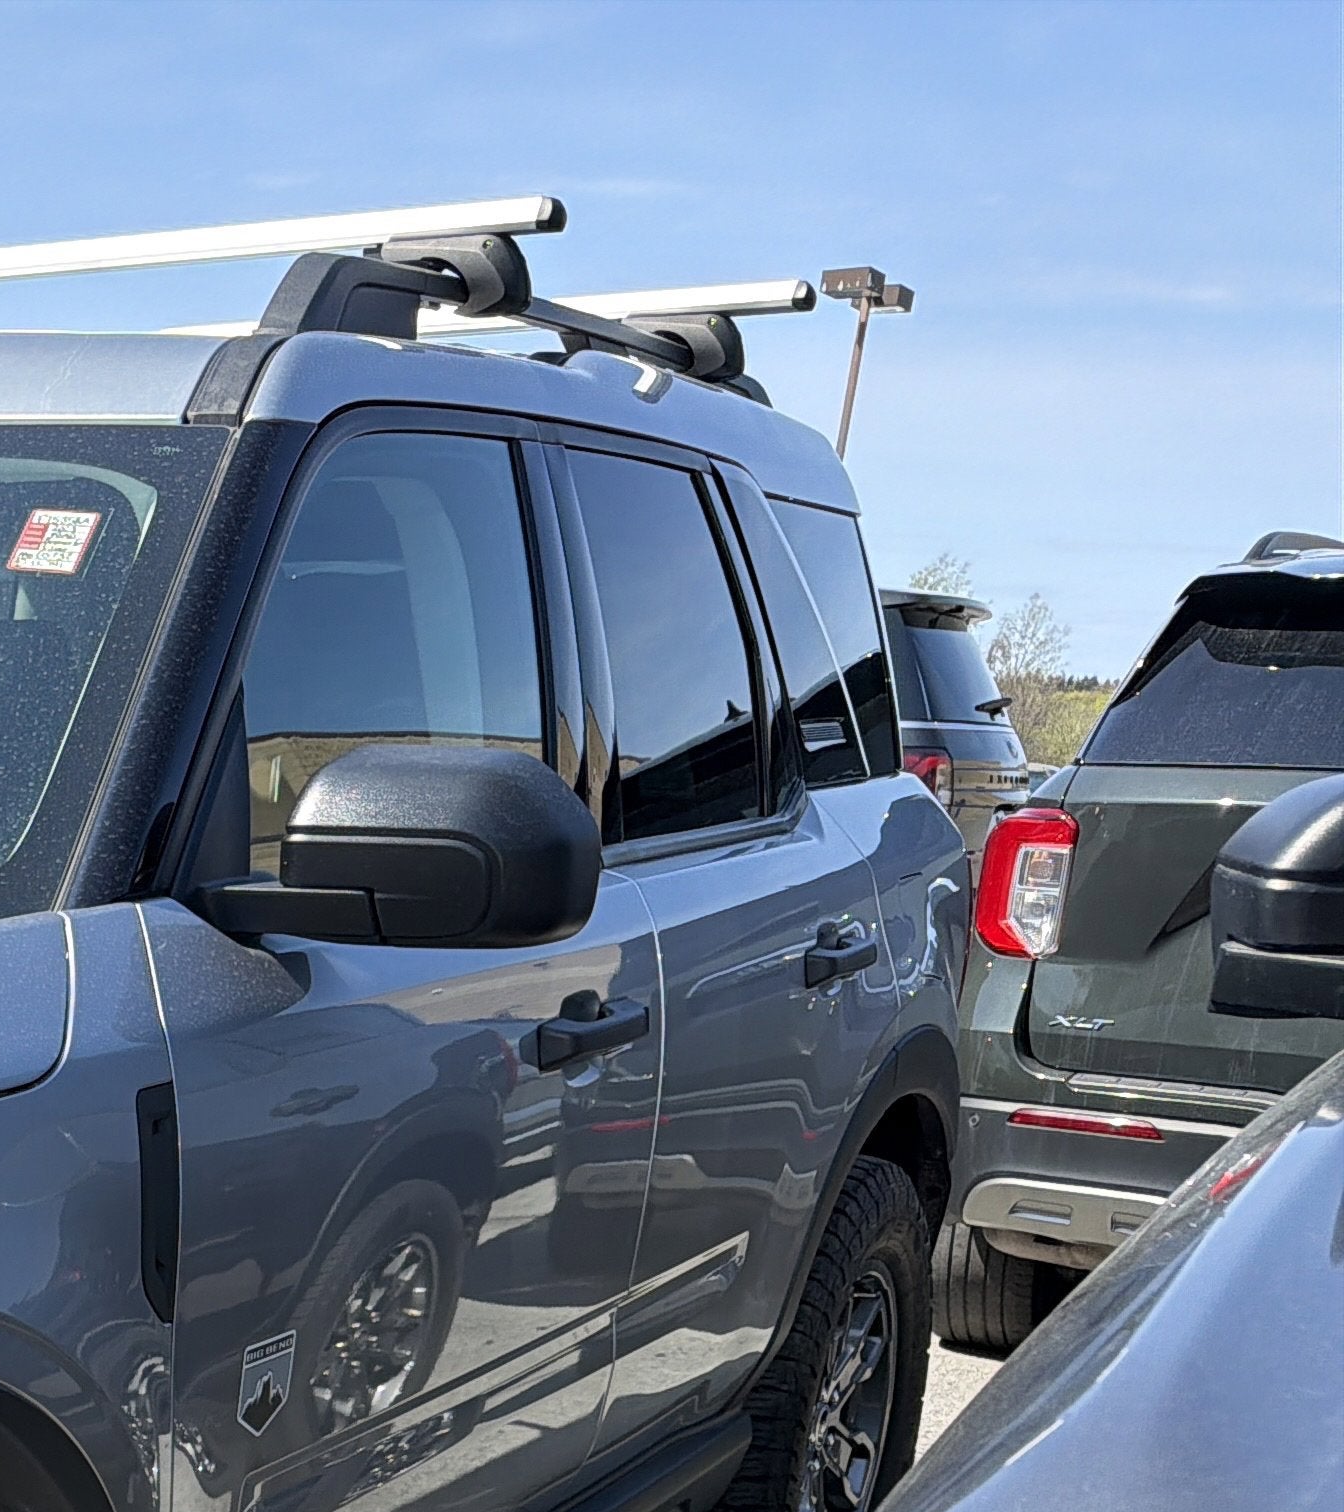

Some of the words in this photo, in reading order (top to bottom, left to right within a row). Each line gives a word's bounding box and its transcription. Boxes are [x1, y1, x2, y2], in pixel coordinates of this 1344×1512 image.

[1048, 1014, 1115, 1031] XLT
[246, 1348, 265, 1363] BIG
[265, 1337, 294, 1355] BEND
